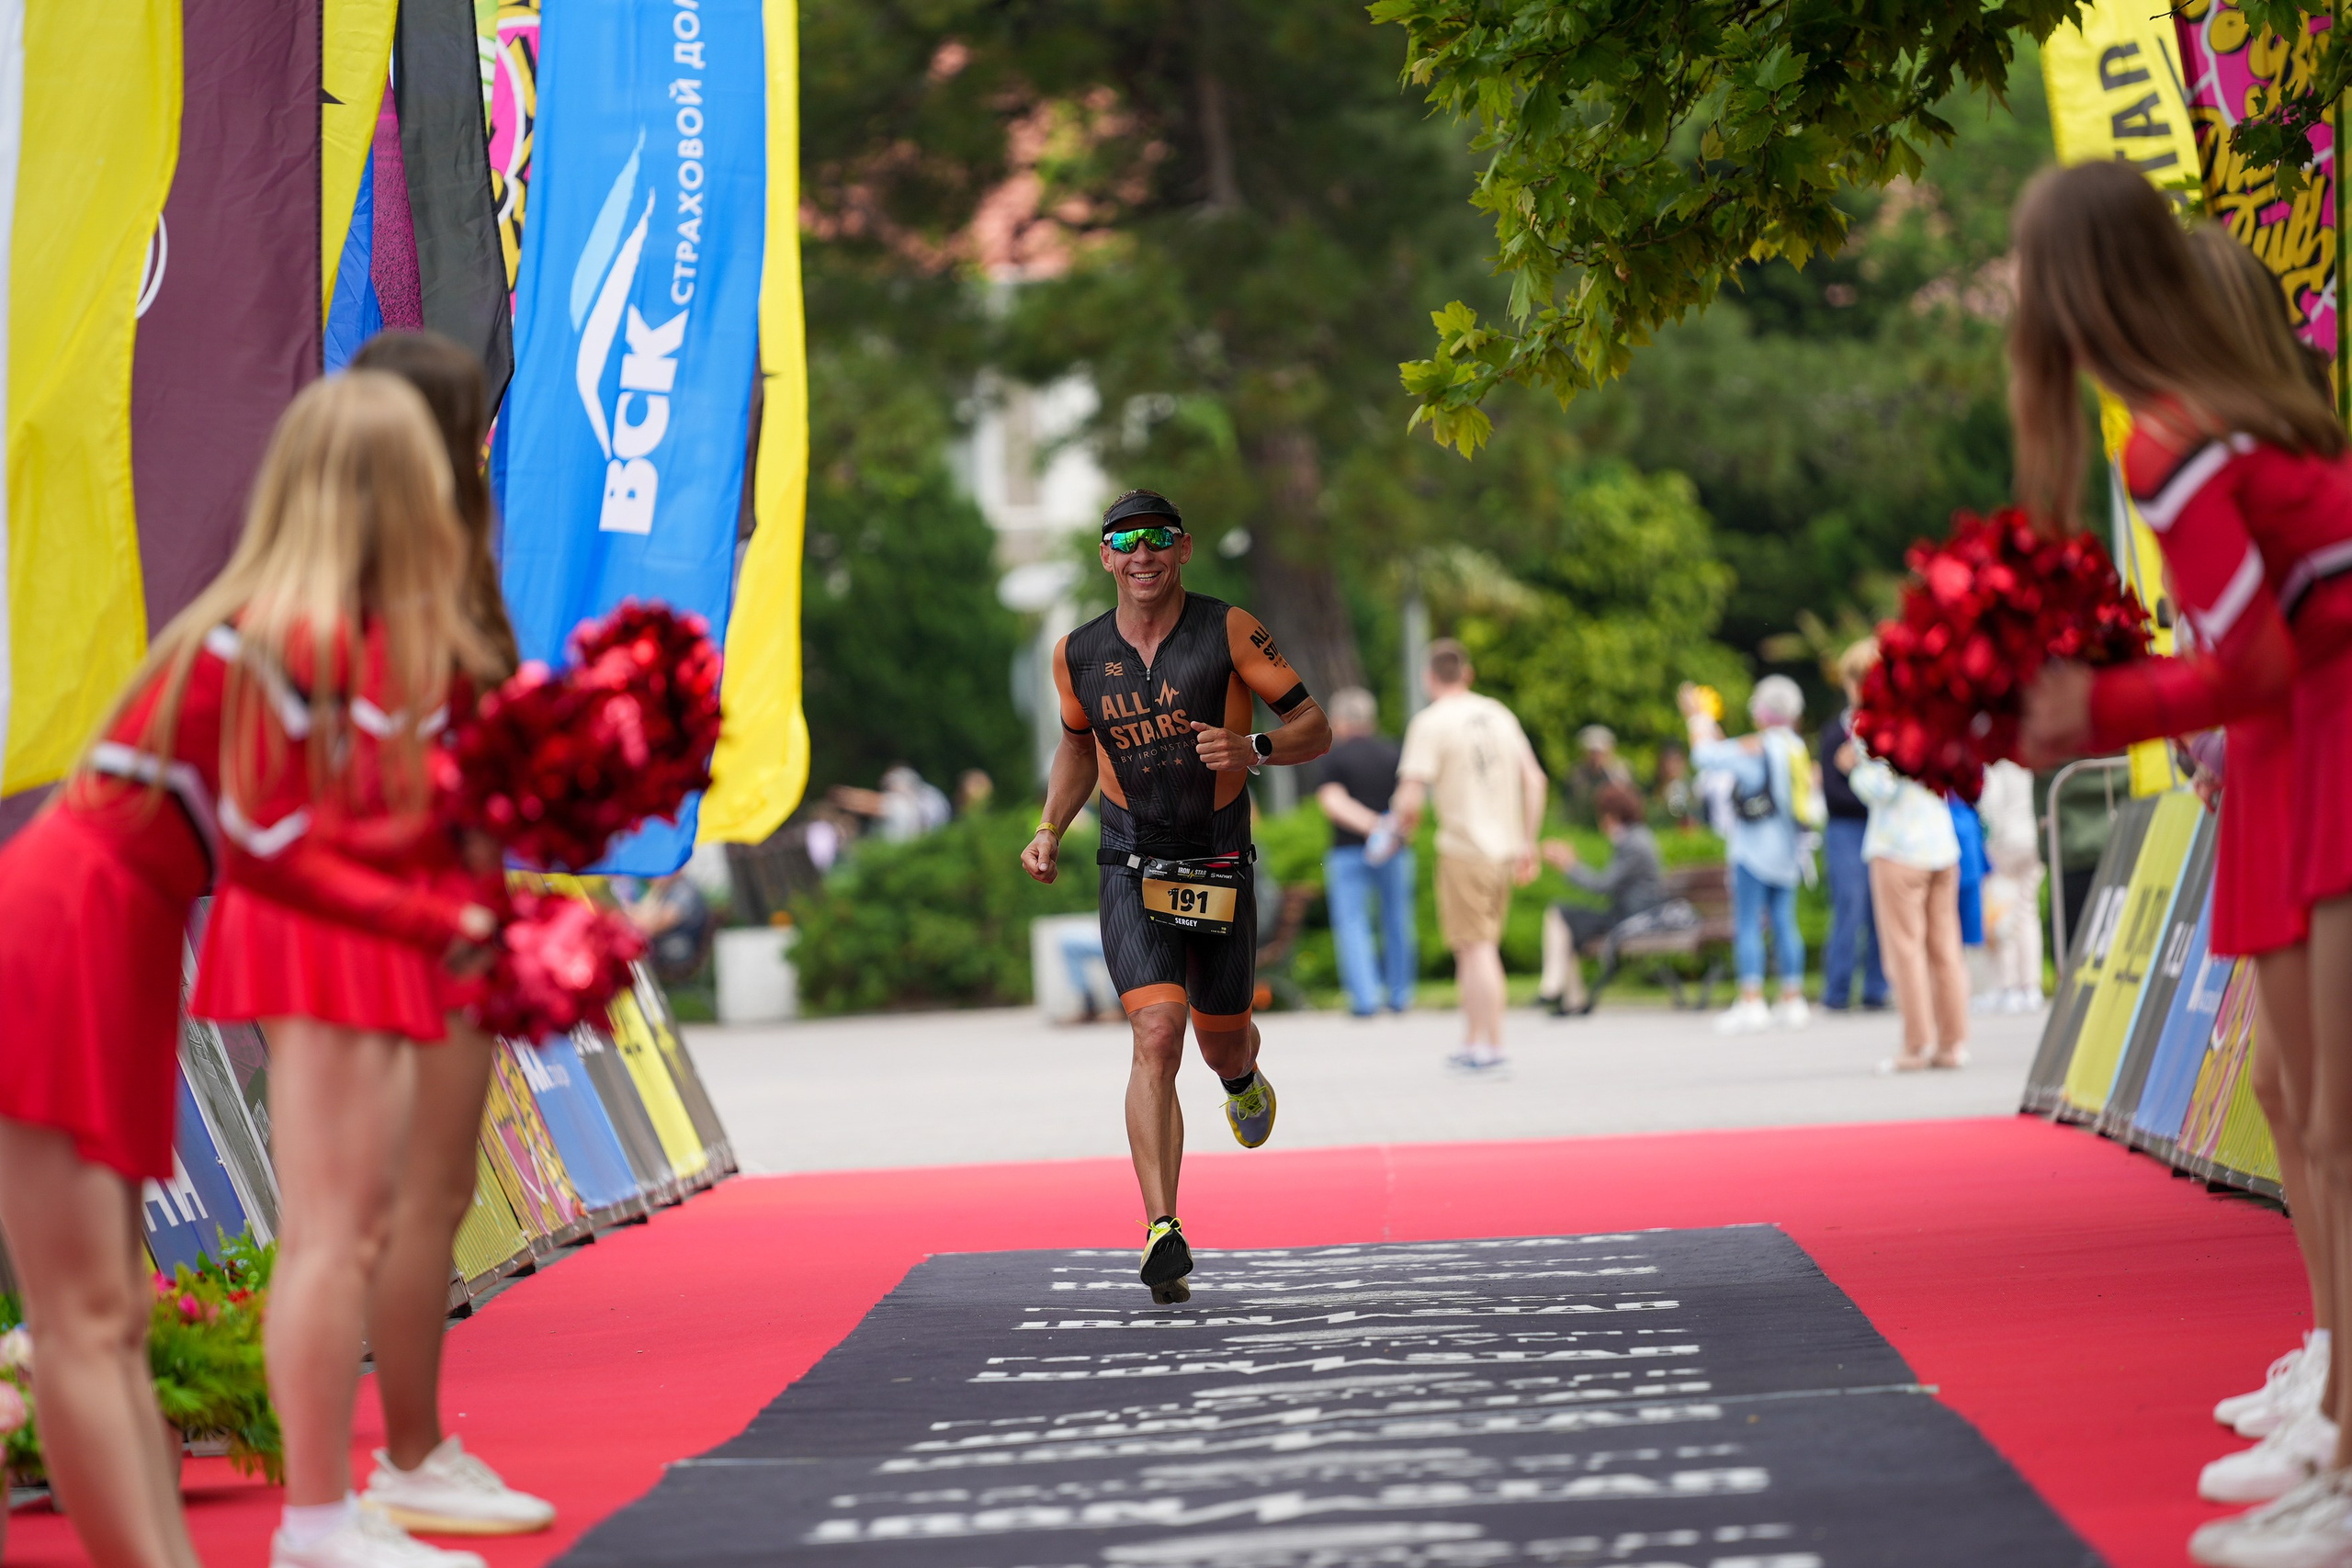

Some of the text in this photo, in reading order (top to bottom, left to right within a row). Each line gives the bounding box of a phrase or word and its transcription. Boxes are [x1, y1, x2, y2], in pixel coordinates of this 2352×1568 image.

[669, 0, 706, 306] СТРАХОВОЙ ДО
[598, 302, 690, 536] ВСК
[1101, 691, 1150, 721] ALL
[1109, 708, 1192, 750] STARS
[1121, 739, 1197, 763] BY IRONSTAR
[1177, 866, 1191, 874] IRON
[1168, 887, 1208, 914] 191
[1174, 917, 1198, 928] SERGEY
[1019, 1300, 1679, 1328] IRON STAR
